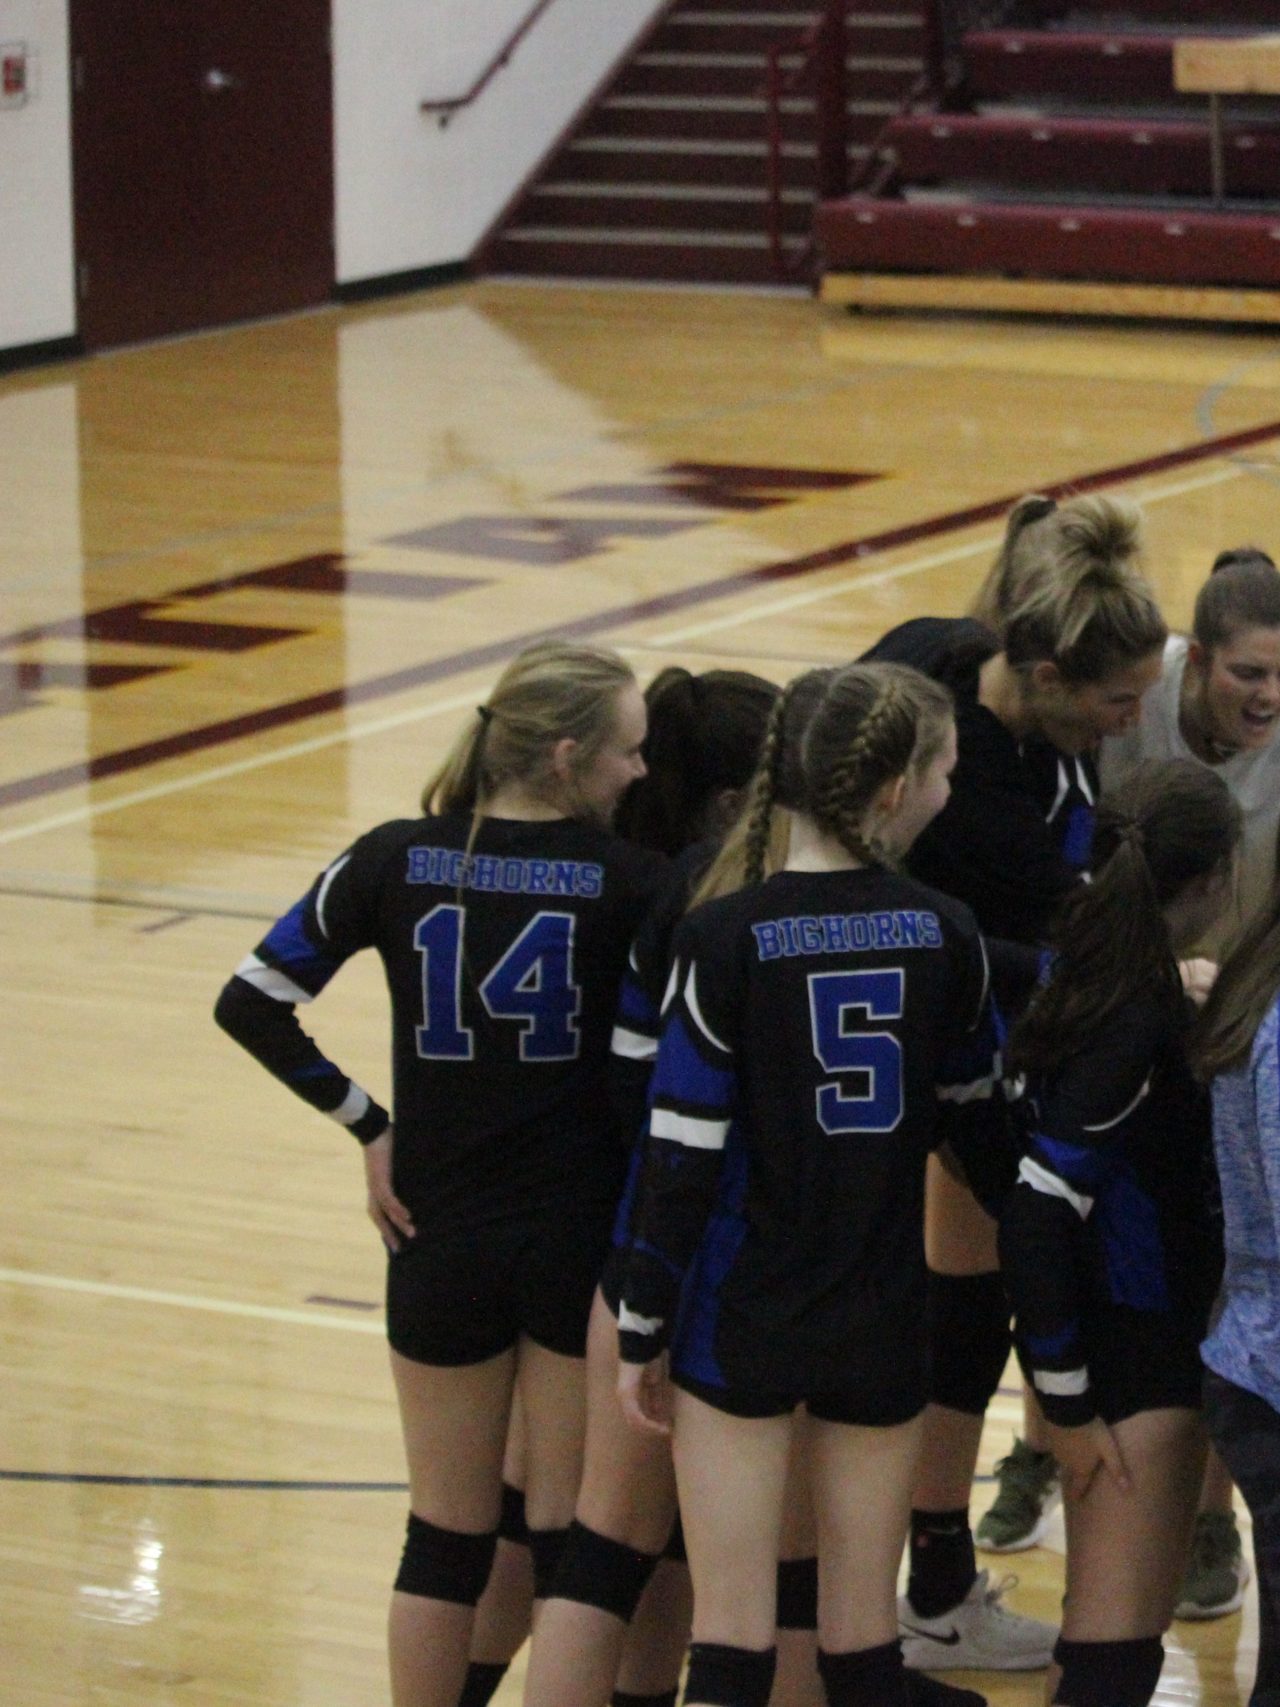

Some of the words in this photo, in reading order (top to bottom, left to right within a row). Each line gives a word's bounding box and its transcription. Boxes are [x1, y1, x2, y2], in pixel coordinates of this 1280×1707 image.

[405, 846, 604, 899] BIGHORNS
[413, 903, 581, 1063] 14
[752, 910, 945, 960] BIGHORNS
[807, 967, 905, 1136] 5
